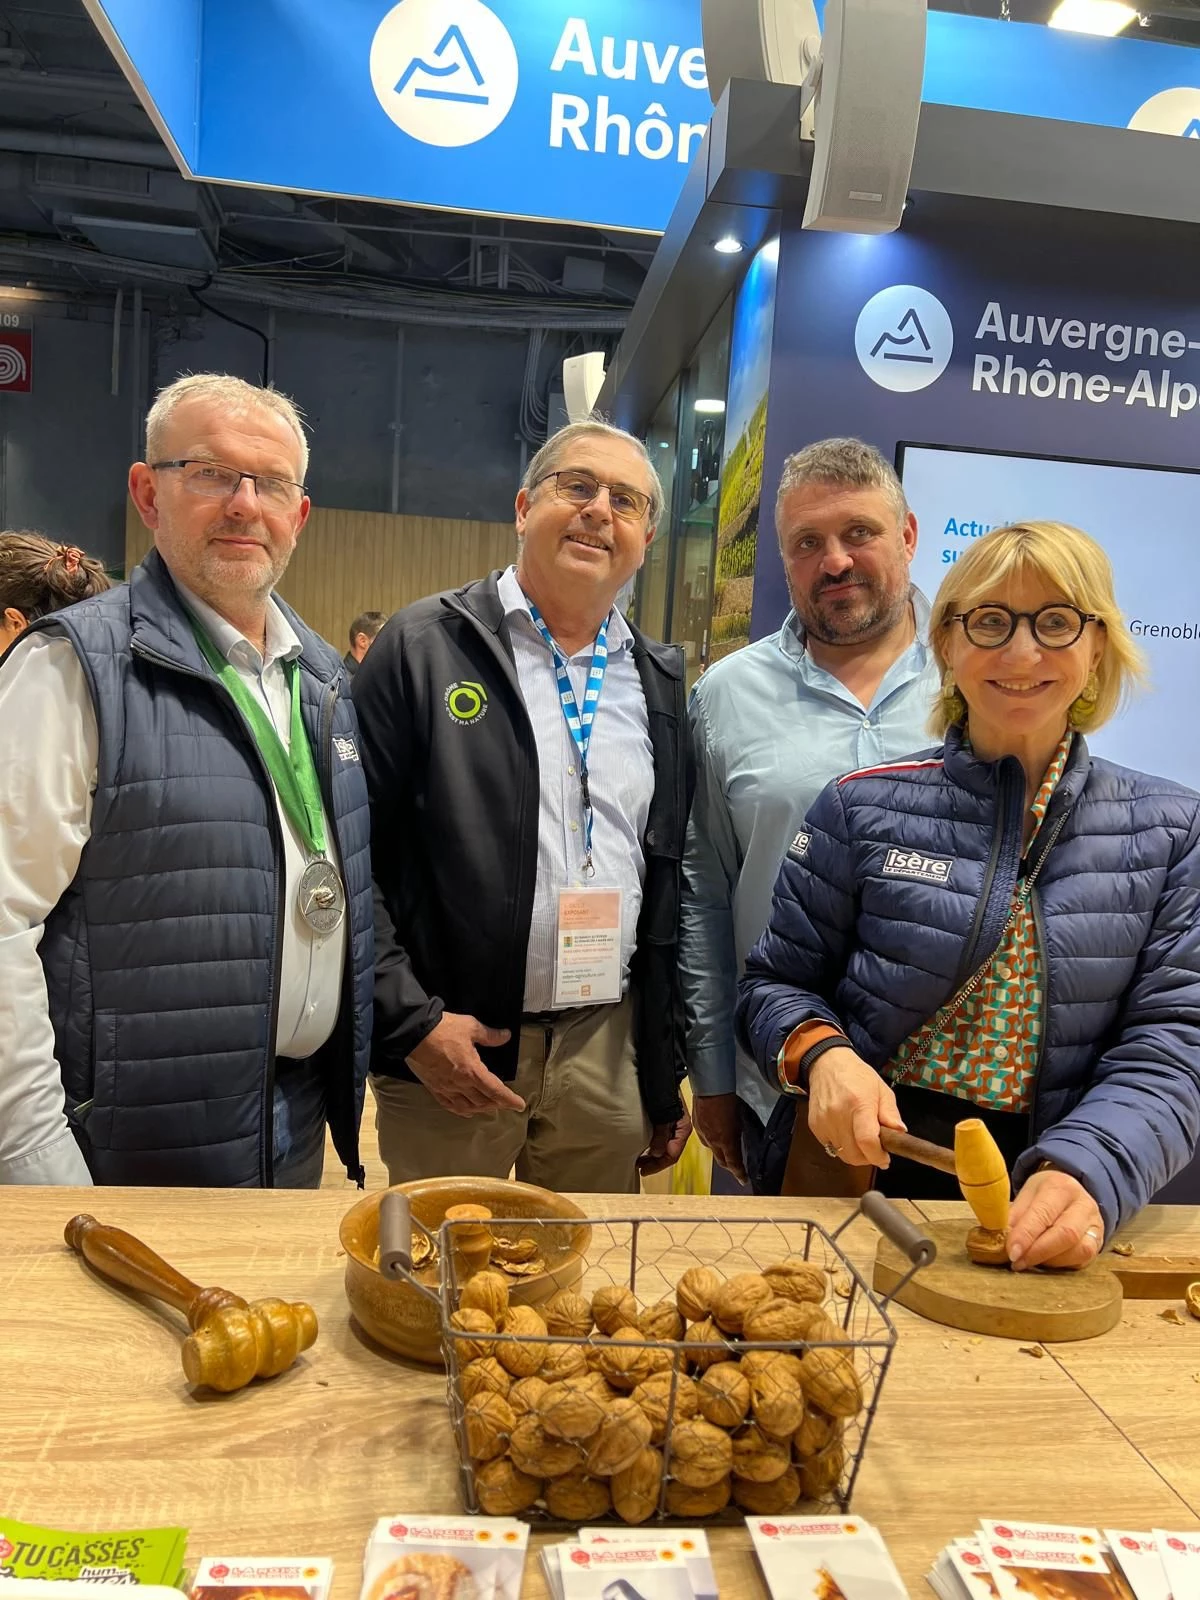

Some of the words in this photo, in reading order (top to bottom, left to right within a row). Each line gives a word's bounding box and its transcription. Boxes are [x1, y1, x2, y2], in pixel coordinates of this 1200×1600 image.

[550, 17, 708, 89] Auve
[975, 302, 1200, 362] Auvergne-
[972, 353, 1200, 418] Rhône-Alp
[1130, 620, 1200, 639] Grenobl
[12, 1541, 47, 1567] TU
[47, 1537, 145, 1568] CASSES
